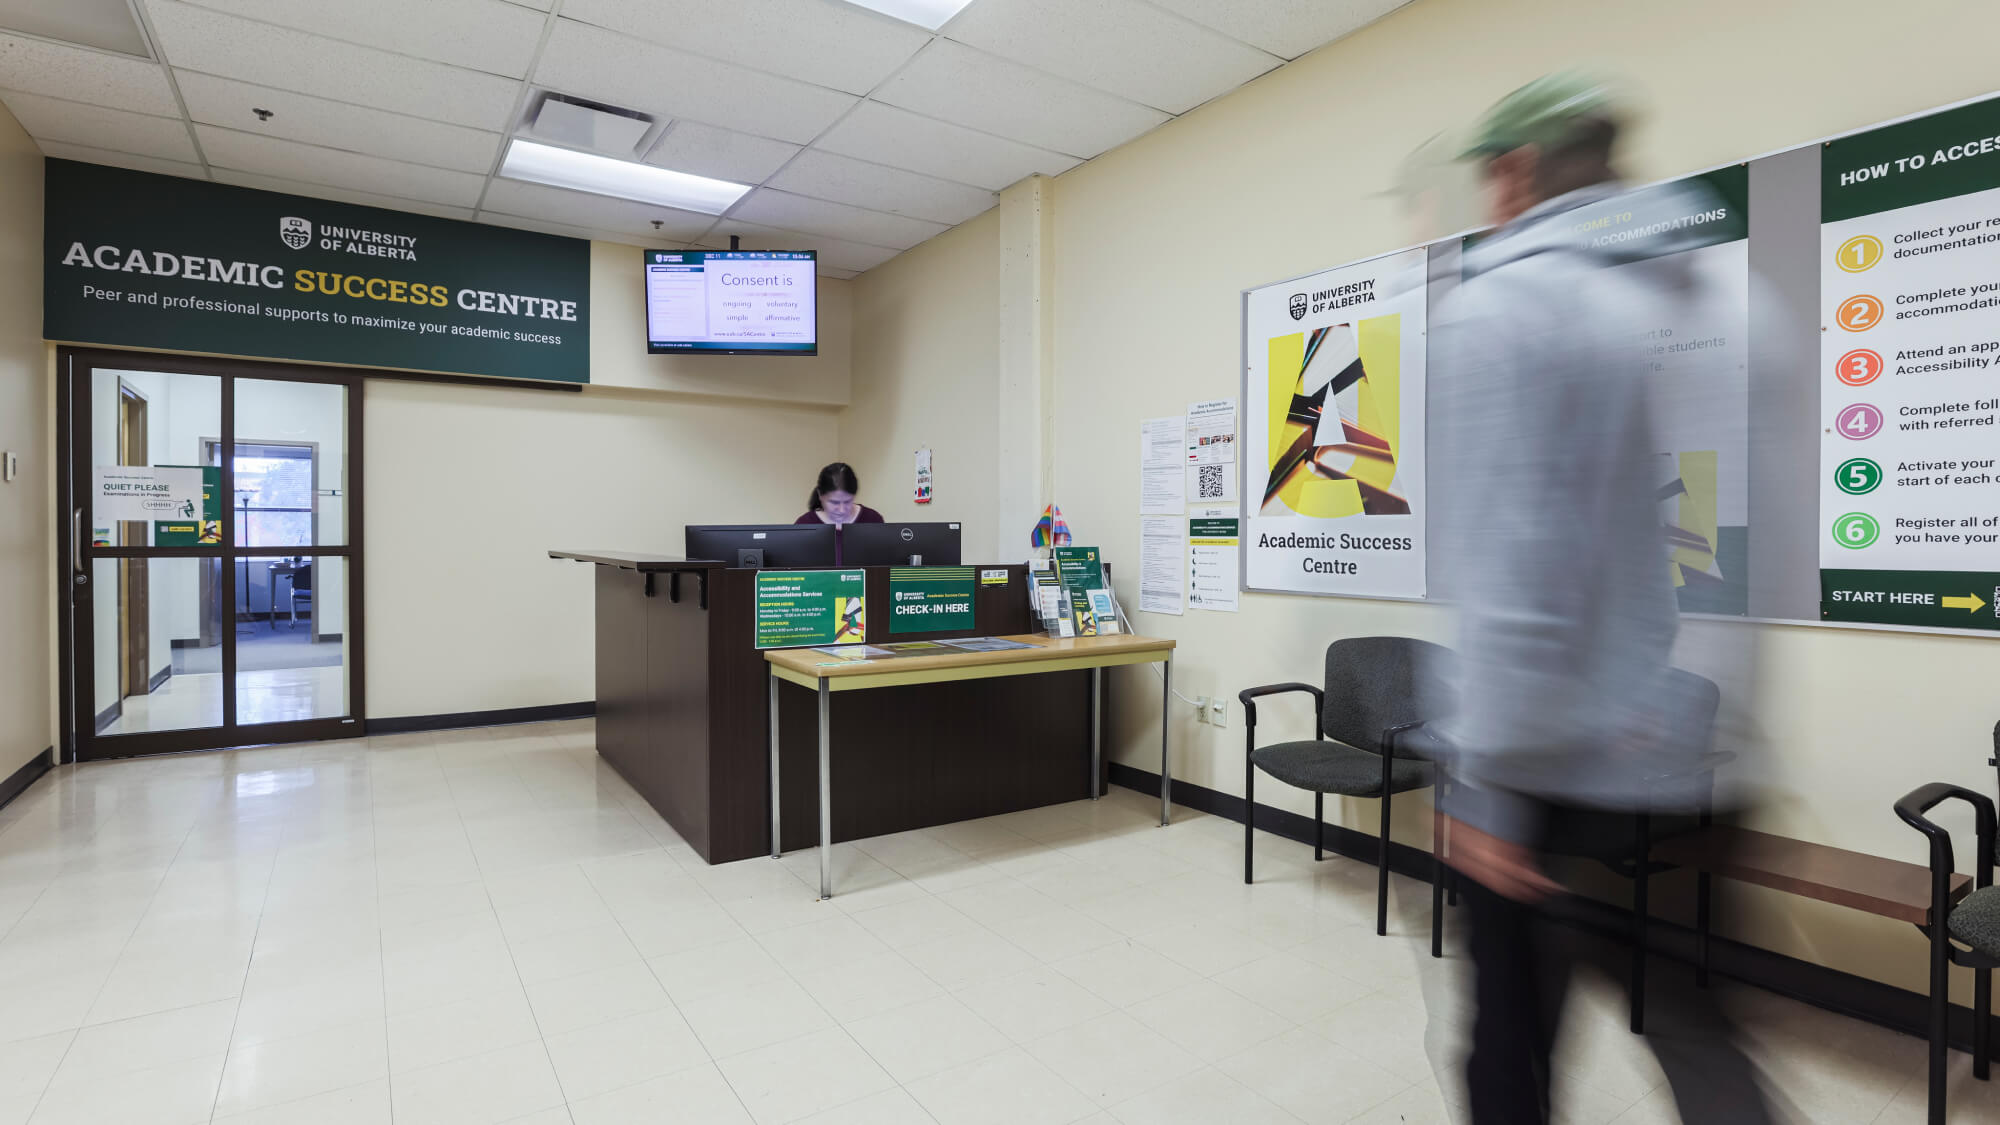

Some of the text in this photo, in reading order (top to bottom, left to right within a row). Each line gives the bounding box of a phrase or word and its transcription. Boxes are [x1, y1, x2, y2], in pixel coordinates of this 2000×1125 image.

[1841, 163, 1889, 186] HOW
[1895, 155, 1925, 173] TO
[1615, 212, 1632, 225] TO
[321, 225, 417, 248] UNIVERSITY
[1591, 208, 1727, 248] ACCOMMODATIONS
[1894, 227, 1944, 243] Collect
[1948, 221, 1982, 237] your
[320, 239, 417, 262] OF ALBERTA
[1852, 242, 1866, 265] 1
[62, 242, 577, 322] ACADEMIC SUCCESS CENTRE
[721, 273, 793, 286] Consent is
[1312, 278, 1375, 302] UNIVERSITY
[1896, 287, 1966, 305] Complete
[766, 300, 798, 308] voluntary
[1312, 291, 1375, 313] OF ALBERTA
[1896, 297, 2000, 319] accommodati
[83, 285, 561, 344] Peer and professional supports to maximize your academic success
[1850, 303, 1869, 325] 2
[1660, 328, 1672, 337] to
[1668, 337, 1726, 352] students
[1896, 341, 2000, 360] Attend an app
[1850, 357, 1868, 379] 3
[1896, 357, 1989, 375] Accessibility
[1899, 399, 1998, 416] Complete foll
[1847, 411, 1868, 433] 4
[1899, 414, 1994, 431] with referred
[1897, 460, 1995, 471] Activate your
[1850, 465, 1867, 487] 5
[1897, 476, 1930, 486] start
[1934, 474, 1950, 485] of
[1954, 473, 1990, 484] each
[104, 483, 170, 492] QUIET PLEASE
[1846, 520, 1865, 541] 6
[1896, 516, 1999, 529] Register all of
[1258, 532, 1412, 550] Academic Success
[1895, 532, 1998, 545] you have your
[1303, 557, 1358, 574] Centre
[1832, 590, 1934, 605] START HERE
[895, 603, 969, 615] CHECK-IN HERE
